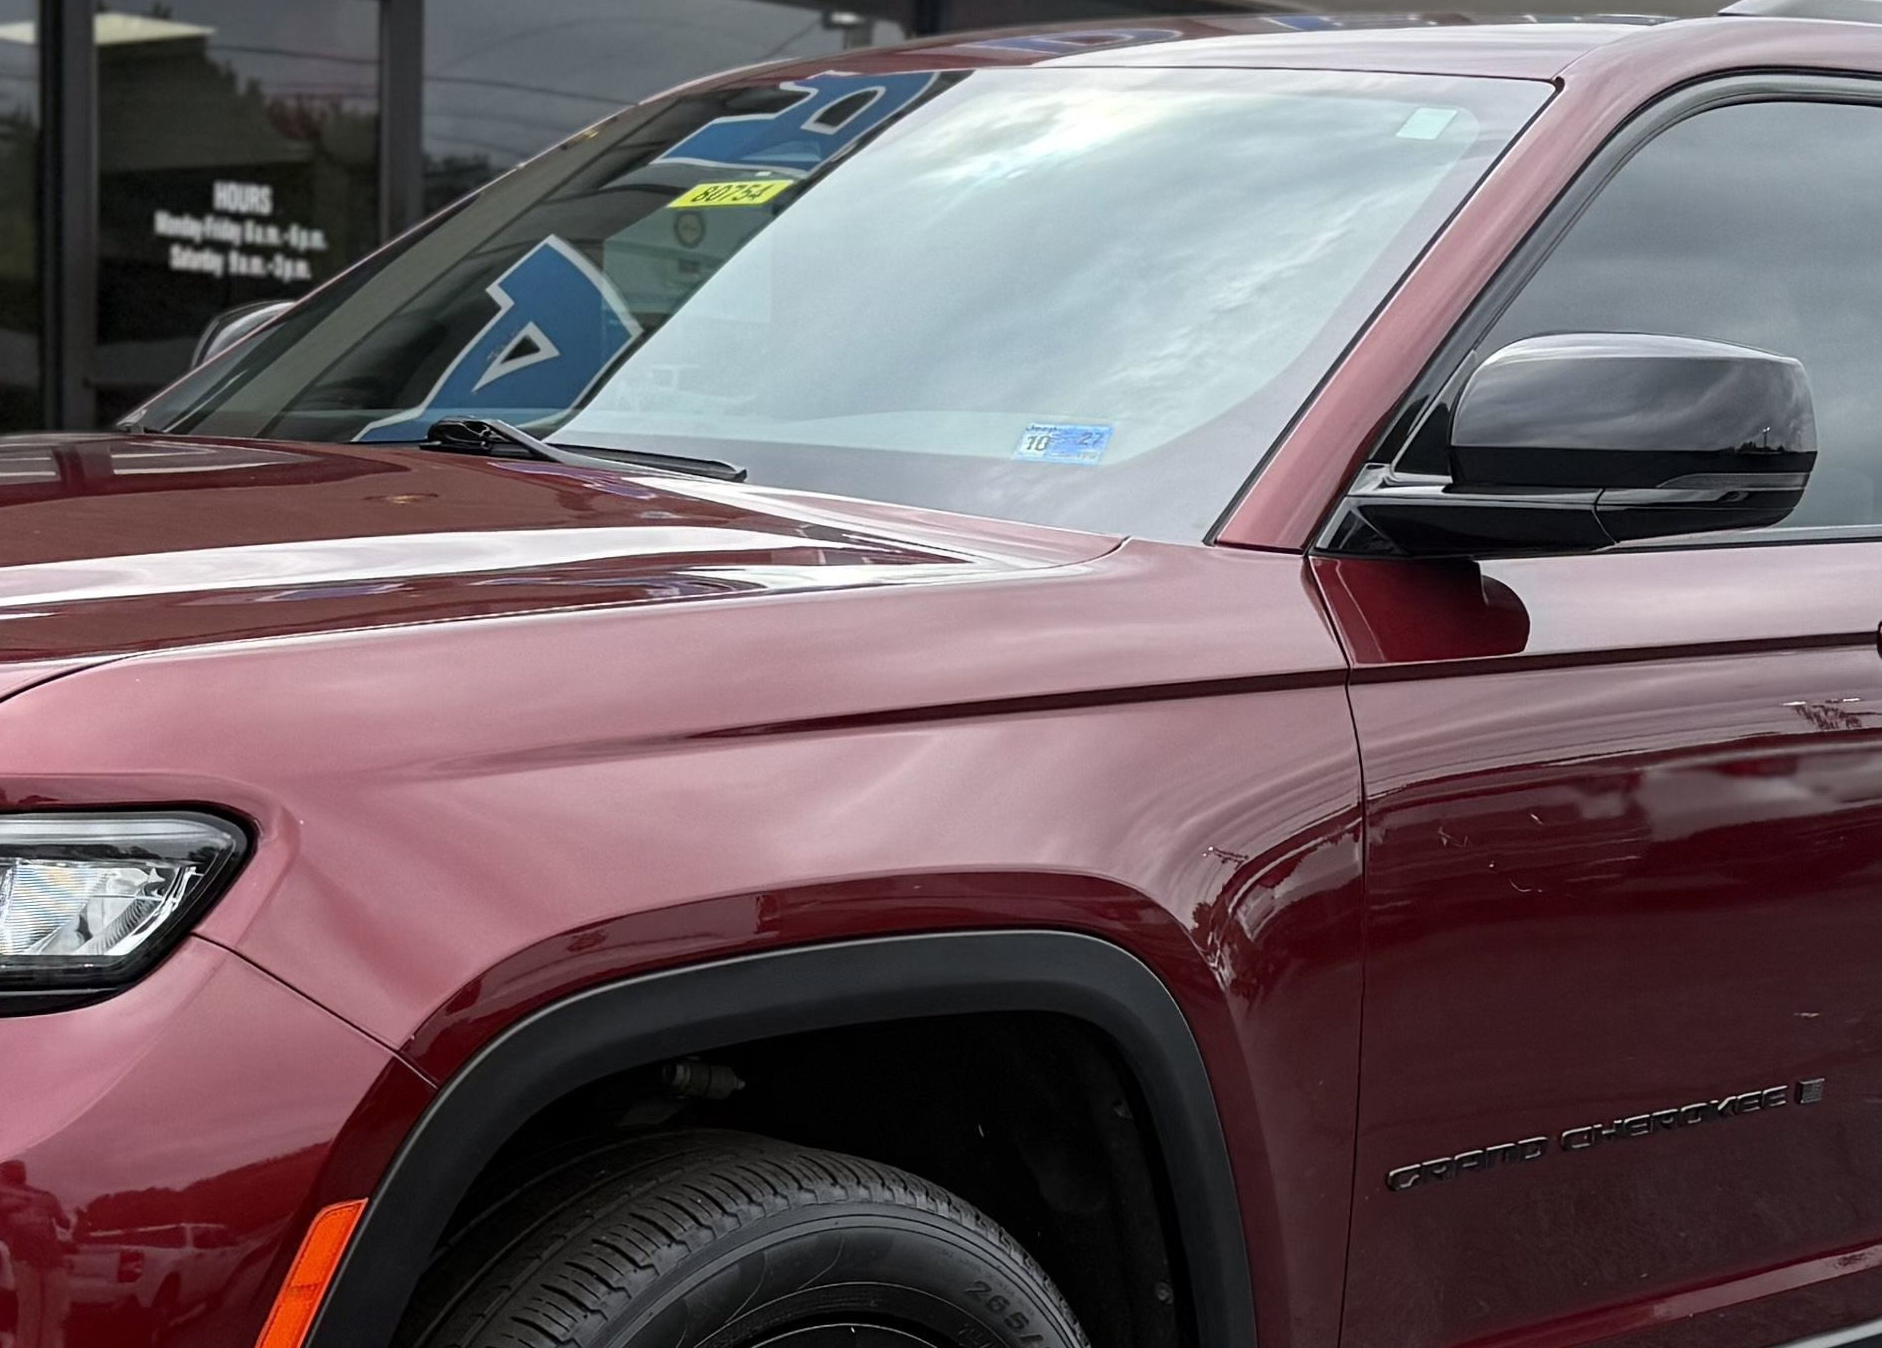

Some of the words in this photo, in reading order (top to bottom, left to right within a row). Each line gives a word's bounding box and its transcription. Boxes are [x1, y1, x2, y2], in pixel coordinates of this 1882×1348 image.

[213, 180, 273, 215] HOURS
[690, 183, 776, 203] 80754
[154, 210, 242, 246] Monday-Friday
[170, 243, 224, 279] Saturday
[1026, 435, 1050, 452] 10
[1077, 431, 1106, 447] 27
[1385, 1135, 1549, 1194] GRAND
[1558, 1083, 1792, 1153] CHEROKEE
